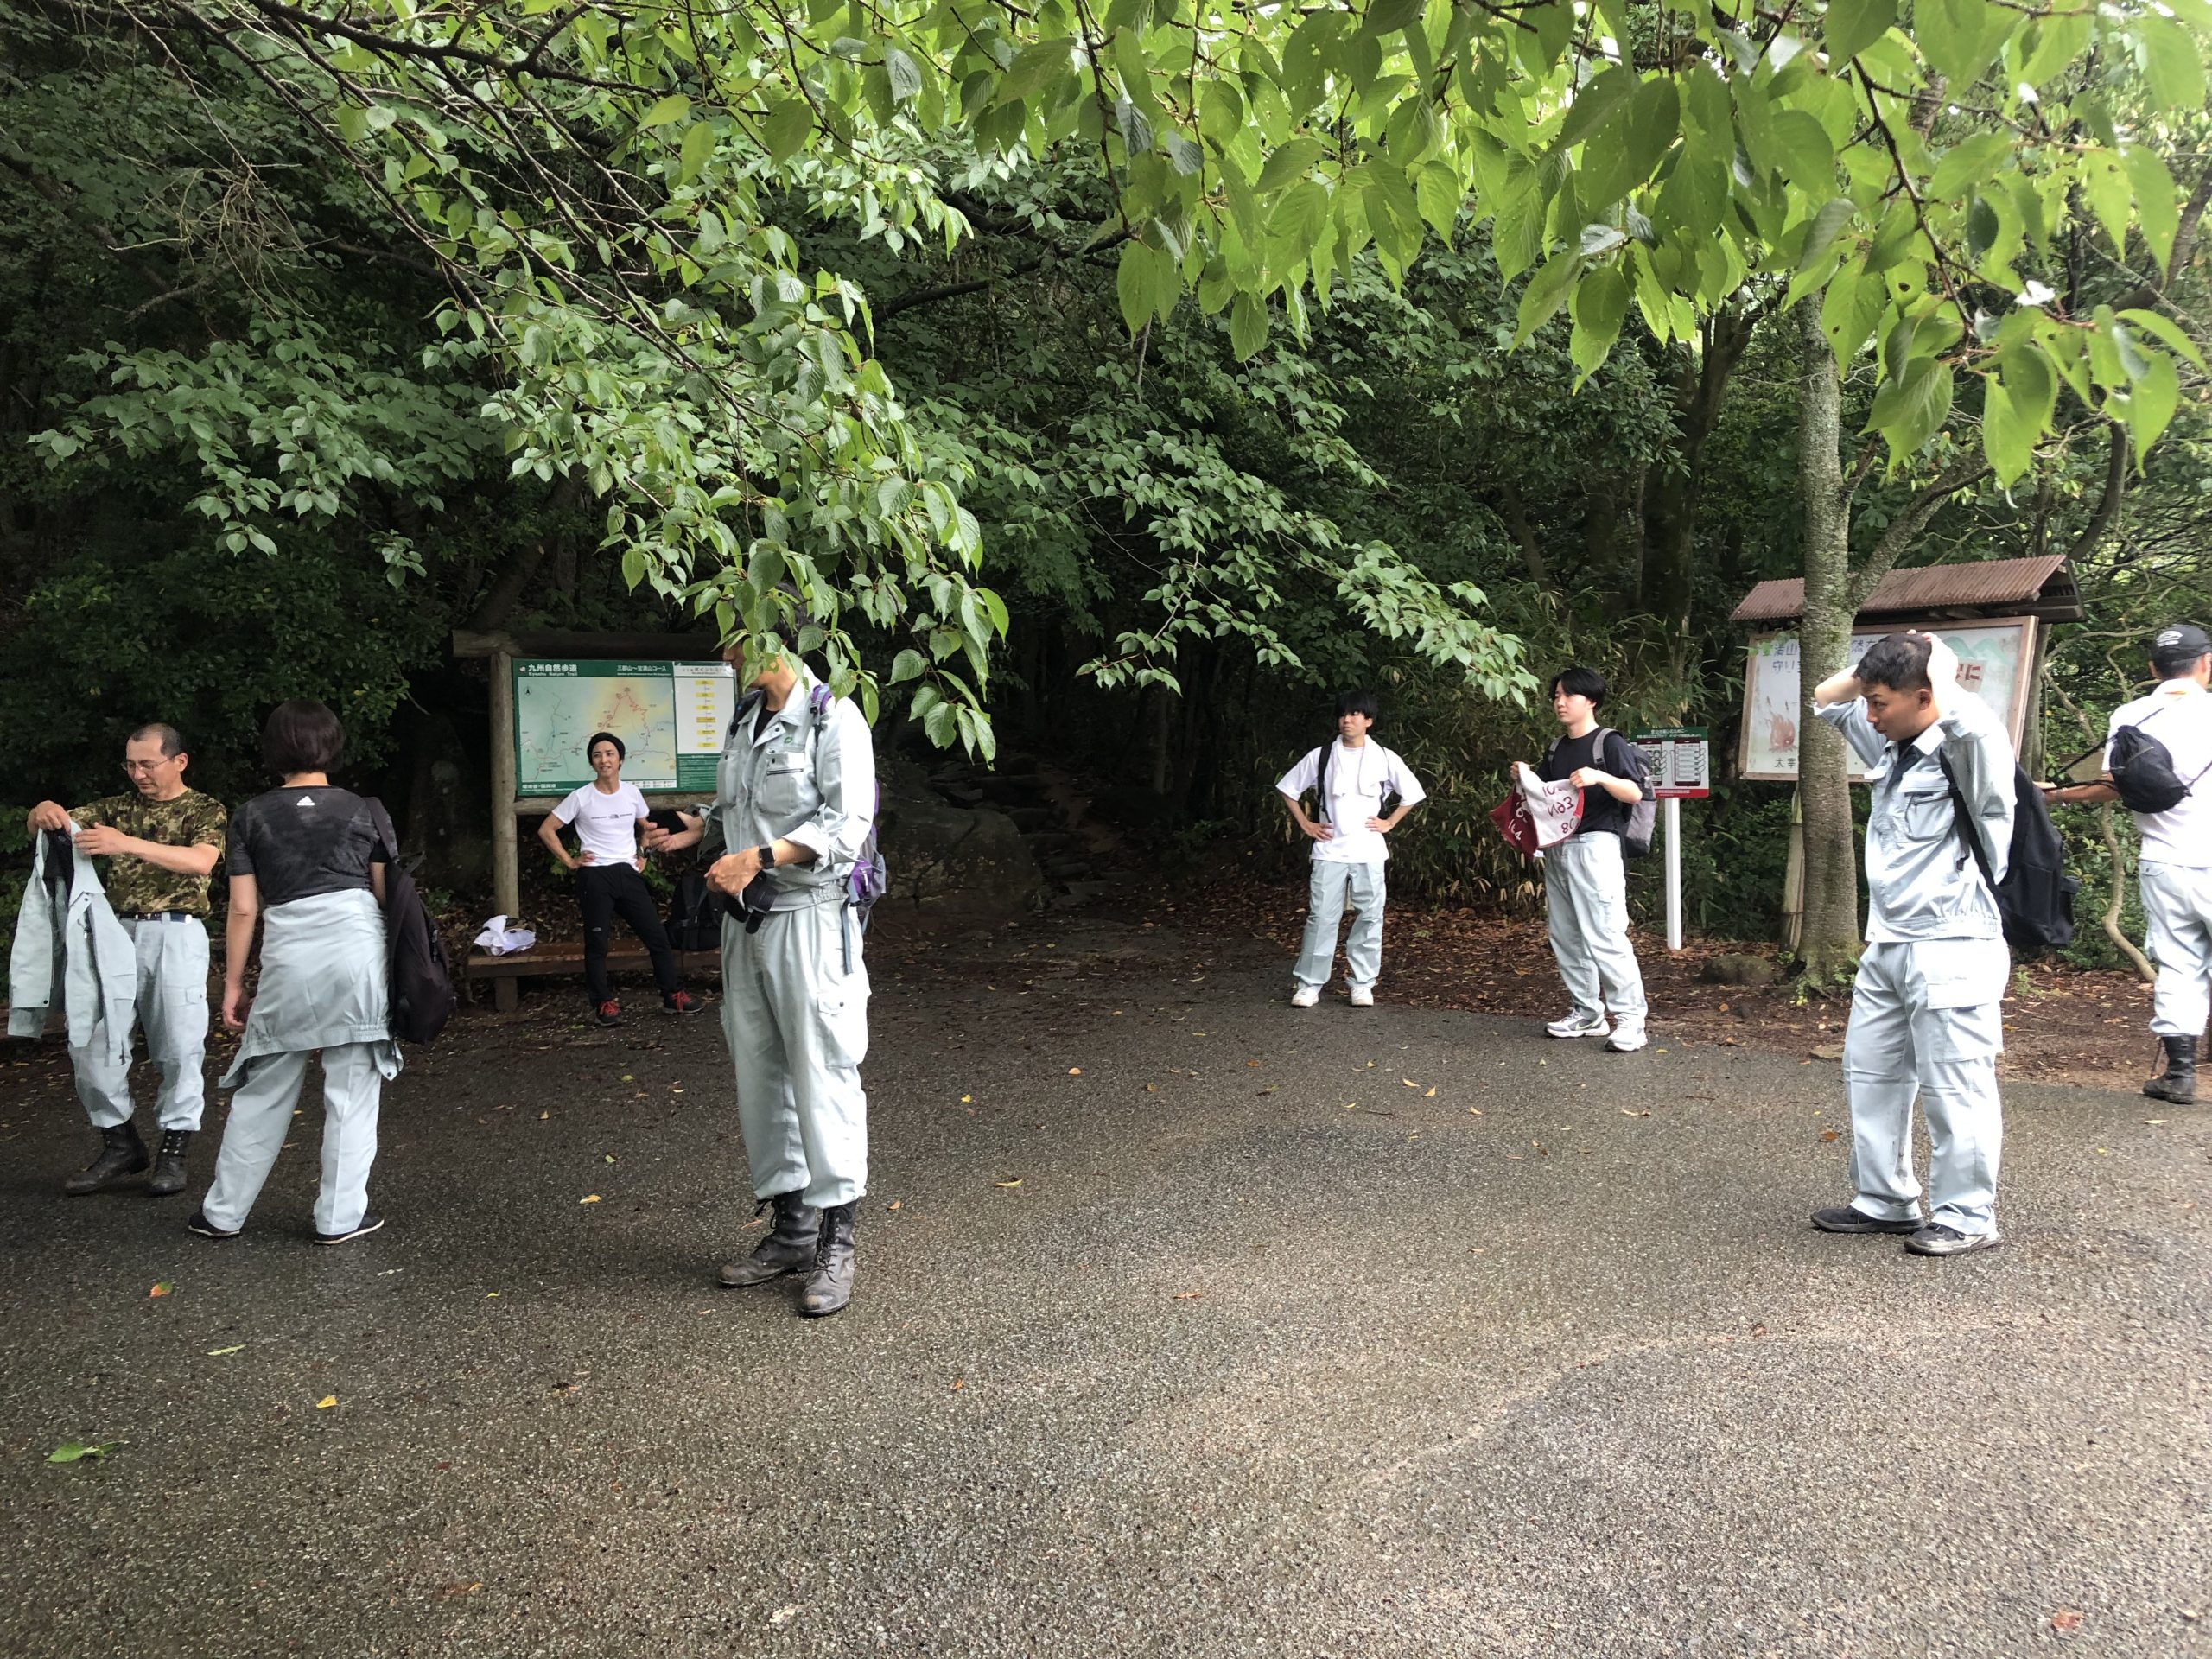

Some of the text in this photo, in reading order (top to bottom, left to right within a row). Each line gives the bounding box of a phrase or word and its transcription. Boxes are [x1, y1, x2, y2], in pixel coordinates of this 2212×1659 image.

[528, 664, 578, 672] 九州自然歩道
[1772, 660, 1801, 675] 守り
